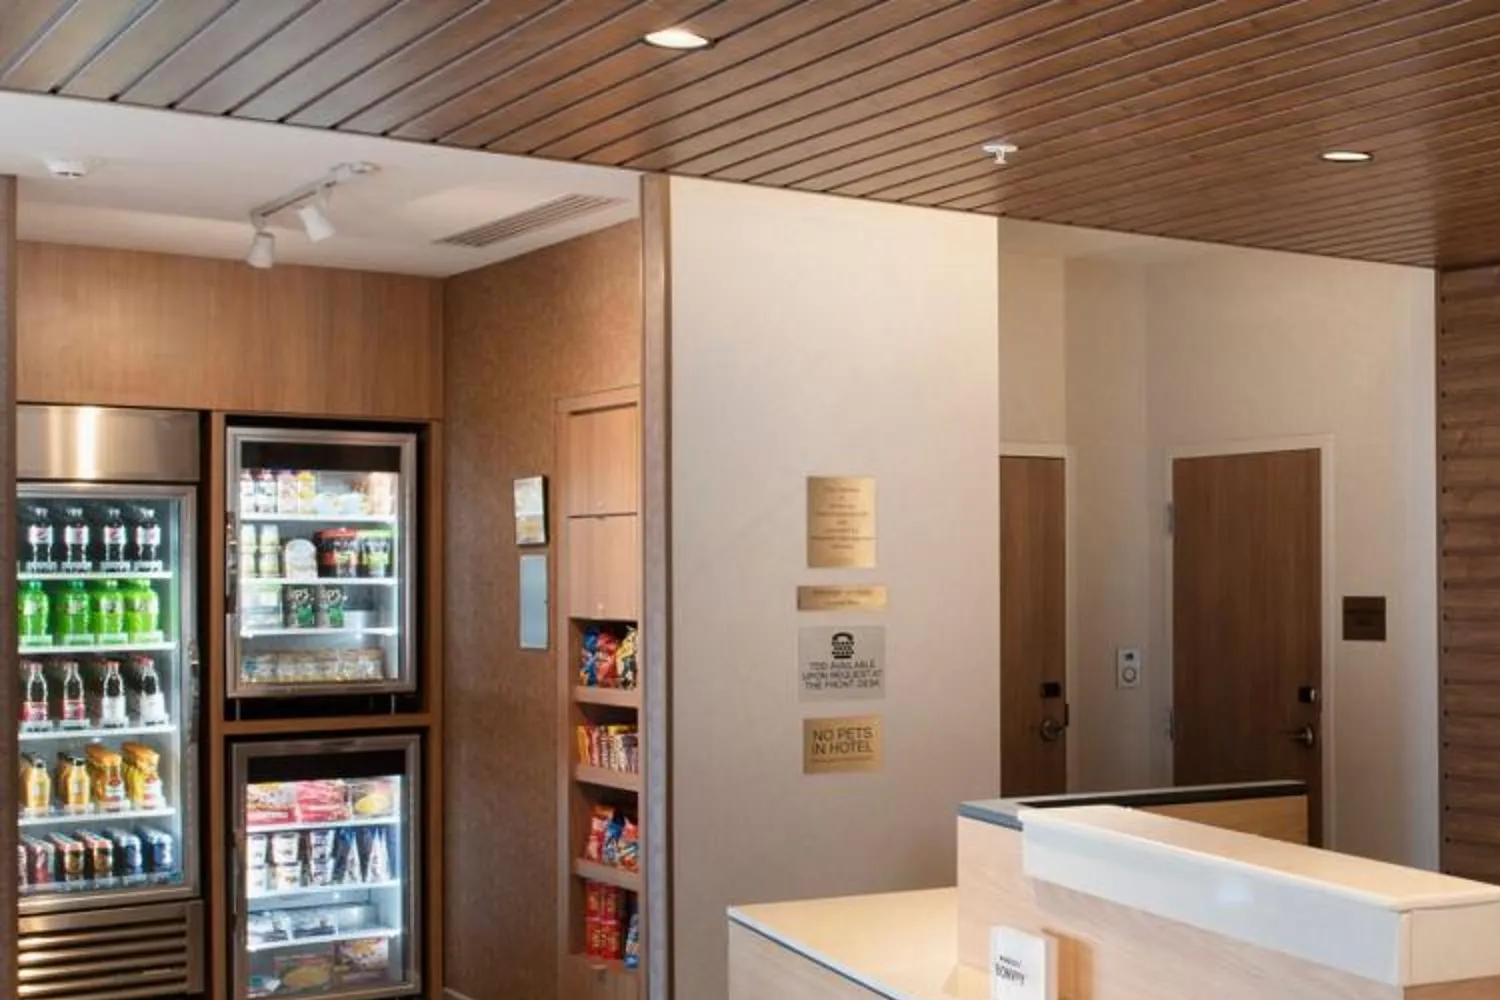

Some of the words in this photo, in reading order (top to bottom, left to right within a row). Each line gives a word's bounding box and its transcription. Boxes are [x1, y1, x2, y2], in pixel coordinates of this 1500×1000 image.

[813, 729, 835, 742] NO
[838, 727, 874, 740] PETS
[811, 742, 826, 755] IN
[829, 740, 874, 755] HOTEL
